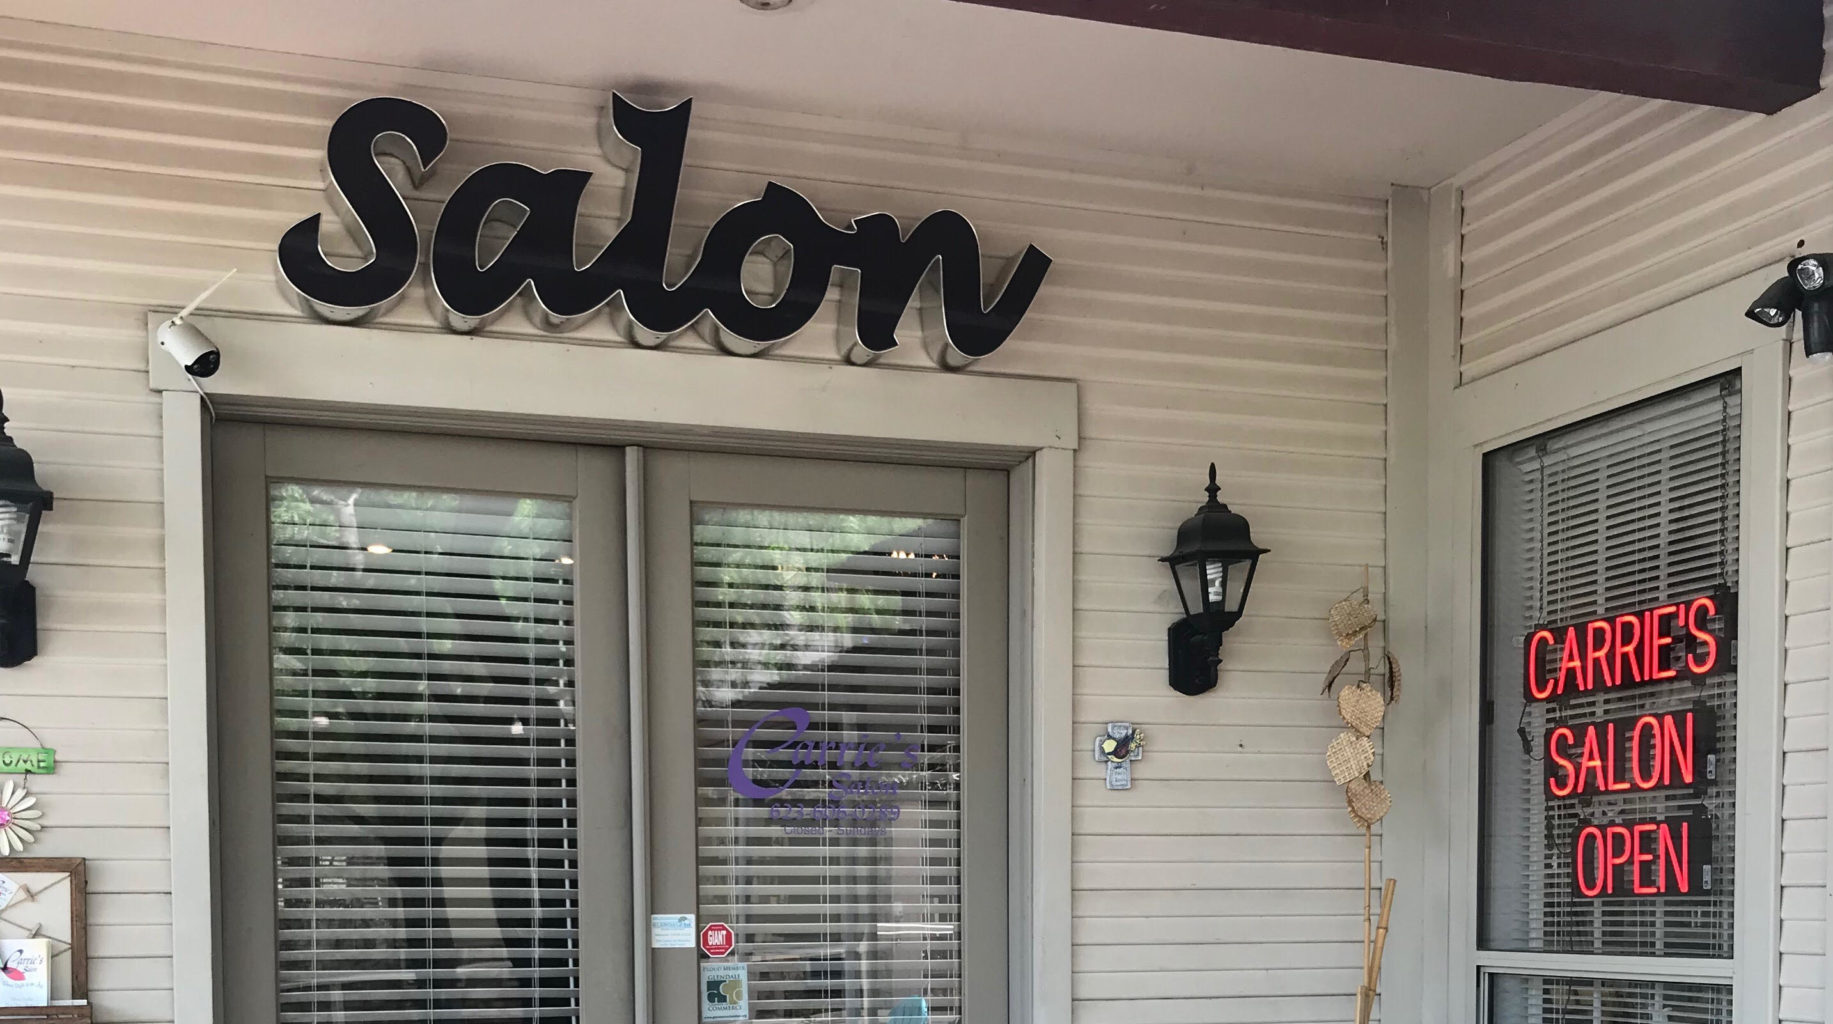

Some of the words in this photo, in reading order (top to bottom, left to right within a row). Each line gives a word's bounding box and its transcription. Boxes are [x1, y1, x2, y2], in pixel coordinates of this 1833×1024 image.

[277, 91, 1053, 362] Salon
[1528, 597, 1718, 700] CARRIE'S
[728, 707, 921, 799] Carrie's
[828, 772, 899, 800] Salon
[1549, 712, 1694, 797] SALON
[1576, 822, 1689, 897] OPEN
[708, 930, 726, 945] GIANT
